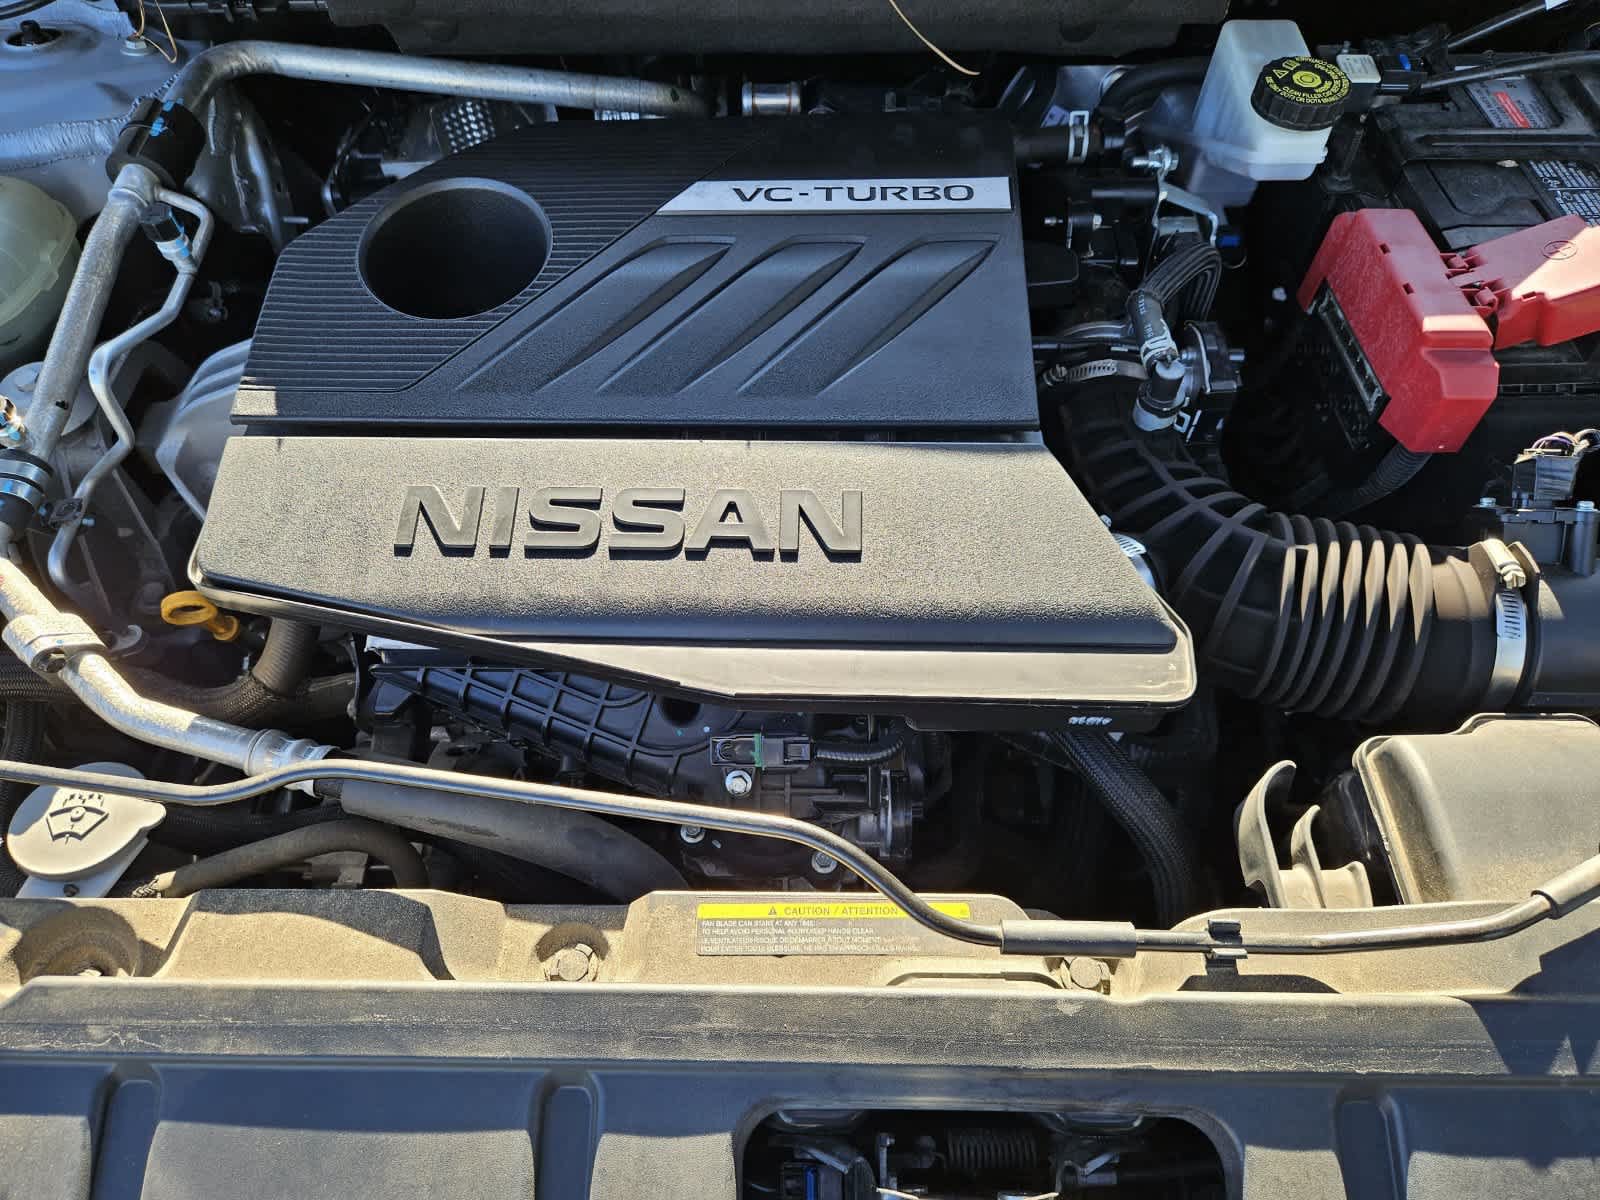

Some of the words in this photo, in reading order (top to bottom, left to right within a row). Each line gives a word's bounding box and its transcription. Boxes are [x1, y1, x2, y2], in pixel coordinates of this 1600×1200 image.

[732, 184, 975, 202] VC-TURBO
[393, 485, 863, 562] NISSAN
[784, 905, 830, 917] CAUTION
[841, 905, 899, 917] ATTENTION
[702, 919, 715, 928] FAN
[715, 919, 737, 928] BLADE
[738, 919, 753, 928] CAN
[754, 919, 775, 928] START
[784, 919, 797, 928] ANY
[712, 928, 728, 936] HELP
[730, 928, 750, 936] AVOID
